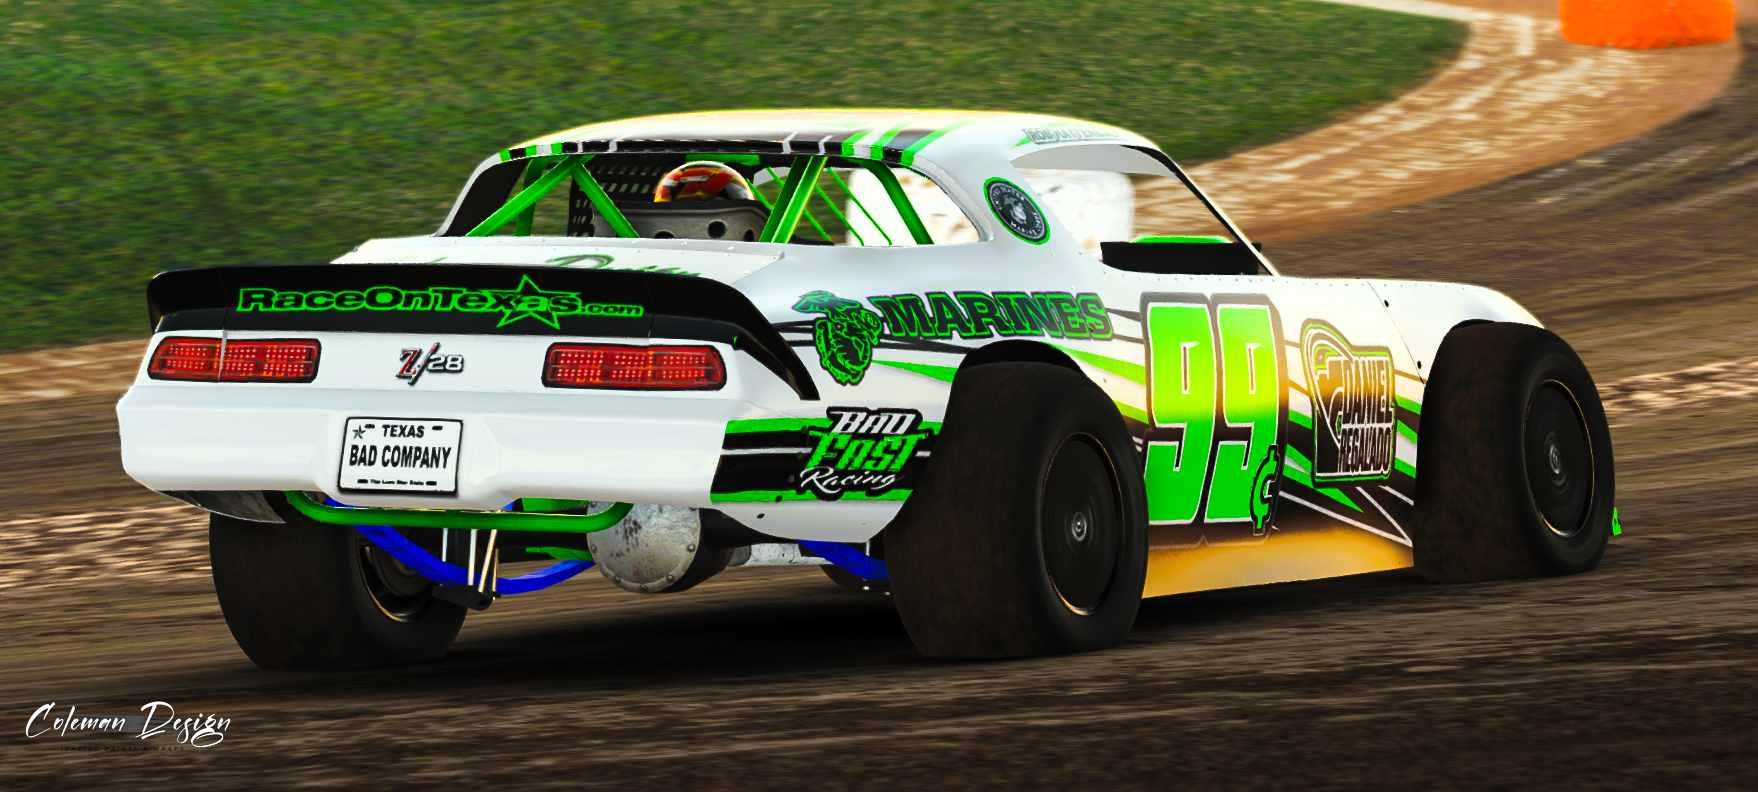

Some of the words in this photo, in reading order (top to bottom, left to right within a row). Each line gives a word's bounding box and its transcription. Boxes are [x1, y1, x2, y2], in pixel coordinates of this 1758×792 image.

[236, 286, 645, 317] RaceOnTexas.com
[867, 291, 1114, 340] MARINES
[396, 342, 464, 385] Z/28
[1341, 358, 1394, 425] DANIEL
[382, 424, 425, 438] TEXAS
[831, 411, 917, 435] BAD
[349, 444, 378, 467] BAD
[381, 445, 452, 469] COMPANY
[1339, 426, 1392, 474] REGALADO
[800, 465, 898, 494] Racing
